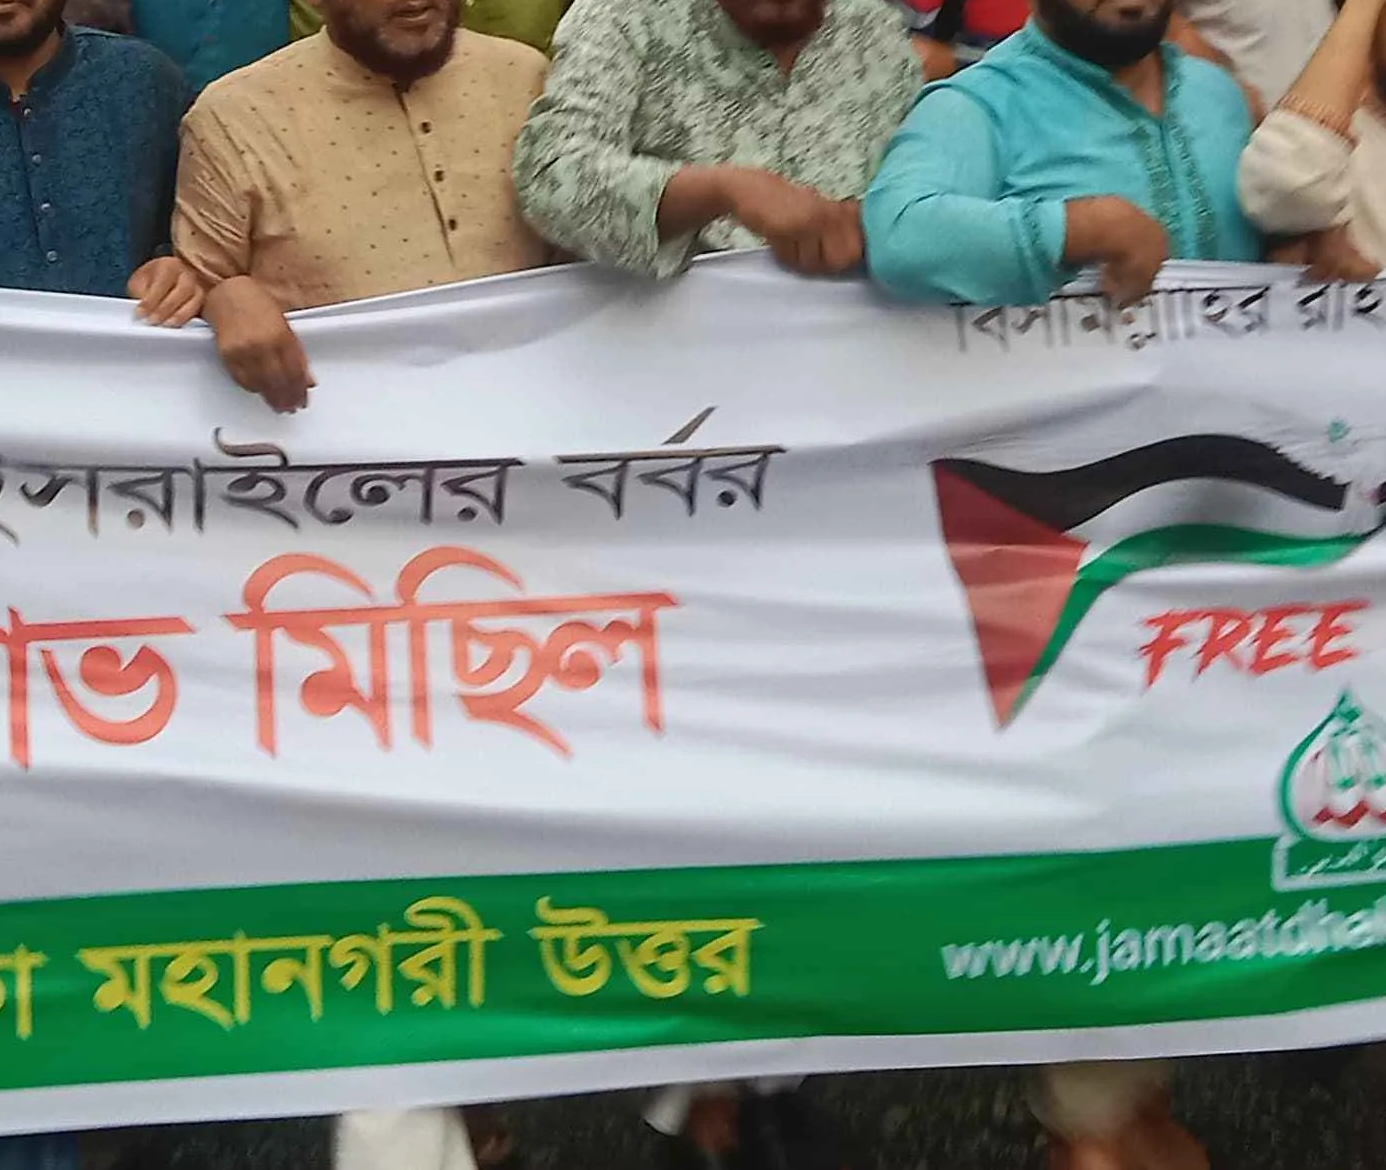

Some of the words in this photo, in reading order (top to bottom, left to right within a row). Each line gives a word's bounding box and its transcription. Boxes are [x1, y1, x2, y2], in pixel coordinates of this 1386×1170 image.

[555, 406, 789, 521] বর্বর
[223, 544, 679, 759] মিছিল
[1138, 598, 1371, 692] FREE
[76, 896, 501, 1028] মহানগরী
[532, 898, 763, 998] উত্তর
